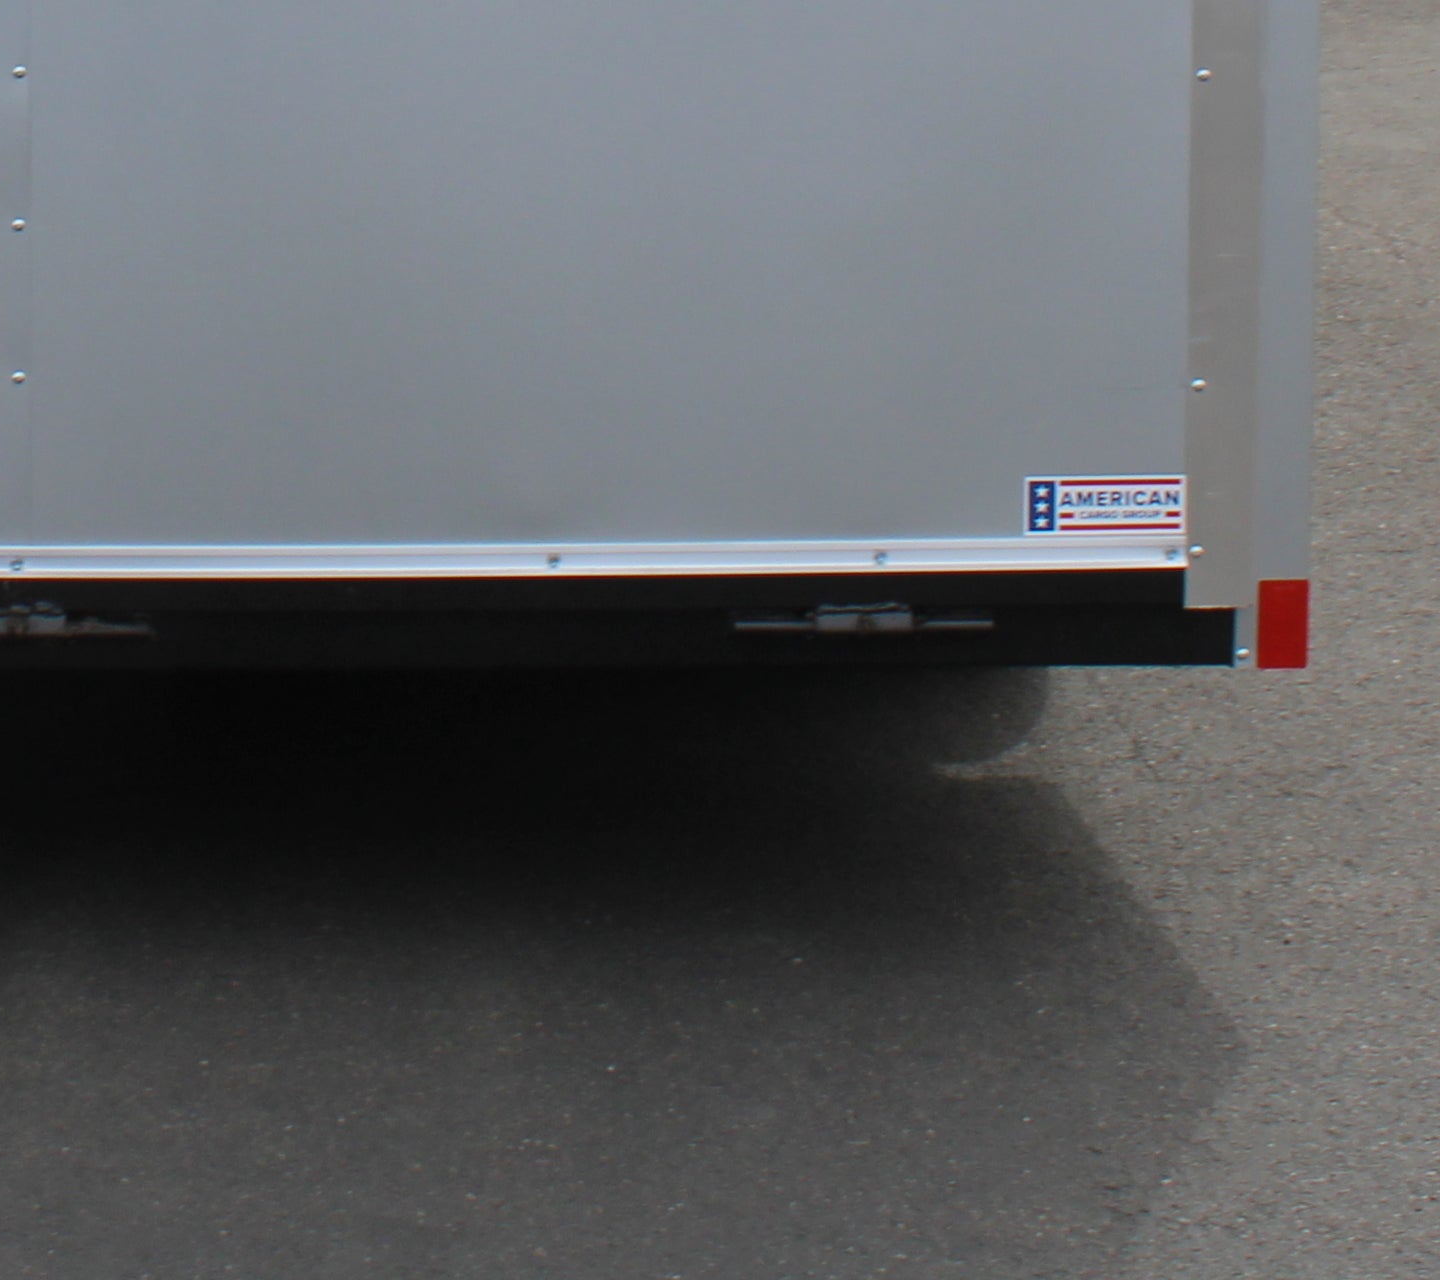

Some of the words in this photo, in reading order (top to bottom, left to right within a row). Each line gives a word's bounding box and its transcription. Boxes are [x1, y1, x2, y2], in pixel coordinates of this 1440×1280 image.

[1059, 491, 1180, 507] AMERICAN
[1079, 510, 1119, 519] CARGO
[1122, 510, 1161, 519] GROUP
